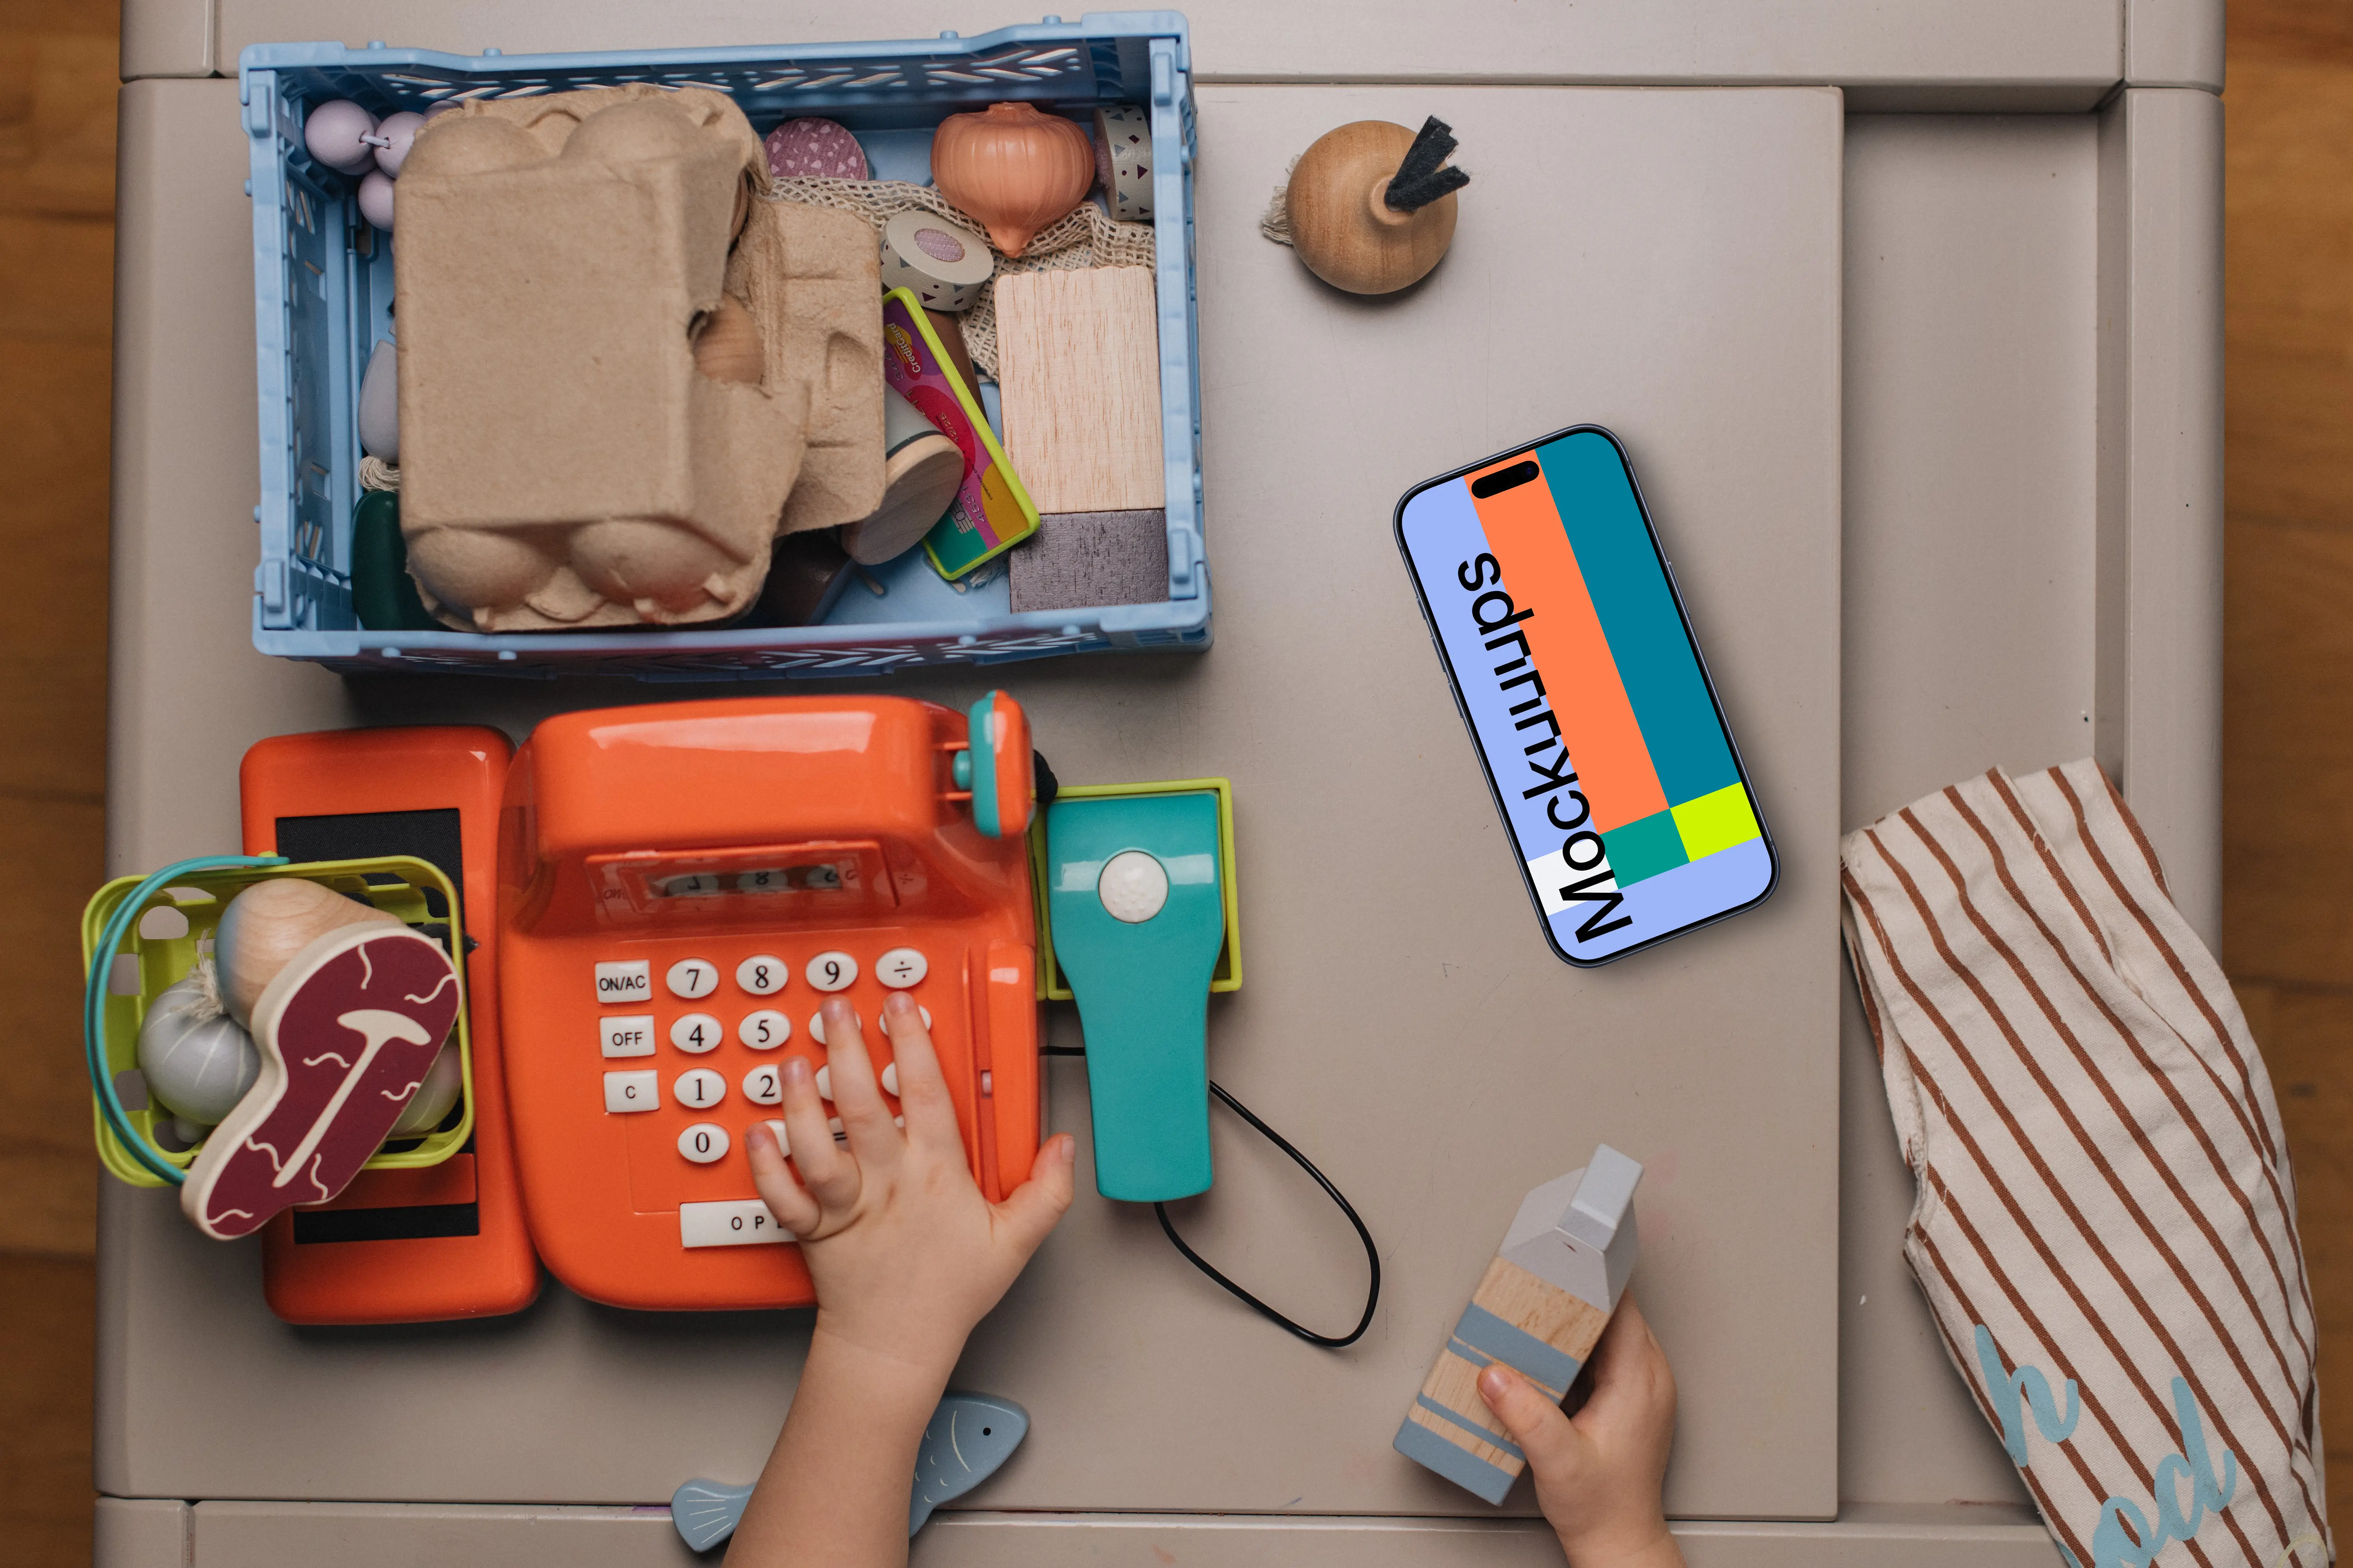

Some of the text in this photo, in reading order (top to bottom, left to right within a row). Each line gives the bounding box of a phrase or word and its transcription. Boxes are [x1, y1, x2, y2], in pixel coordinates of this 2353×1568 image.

[887, 323, 921, 373] CreditCard
[940, 412, 959, 443] 12/25
[962, 486, 986, 522] 4531
[1458, 552, 1633, 943] Mockuuups
[599, 975, 646, 991] ON/AC
[687, 968, 700, 991] 7
[755, 965, 769, 988] 8
[825, 961, 840, 985] 9
[612, 1032, 643, 1046] OFF
[689, 1024, 705, 1047] 4
[757, 1019, 770, 1043] 5
[626, 1086, 636, 1099] C
[695, 1078, 704, 1101] 1
[760, 1075, 775, 1097] 2
[695, 1132, 710, 1153] 0
[731, 1216, 783, 1230] OP
